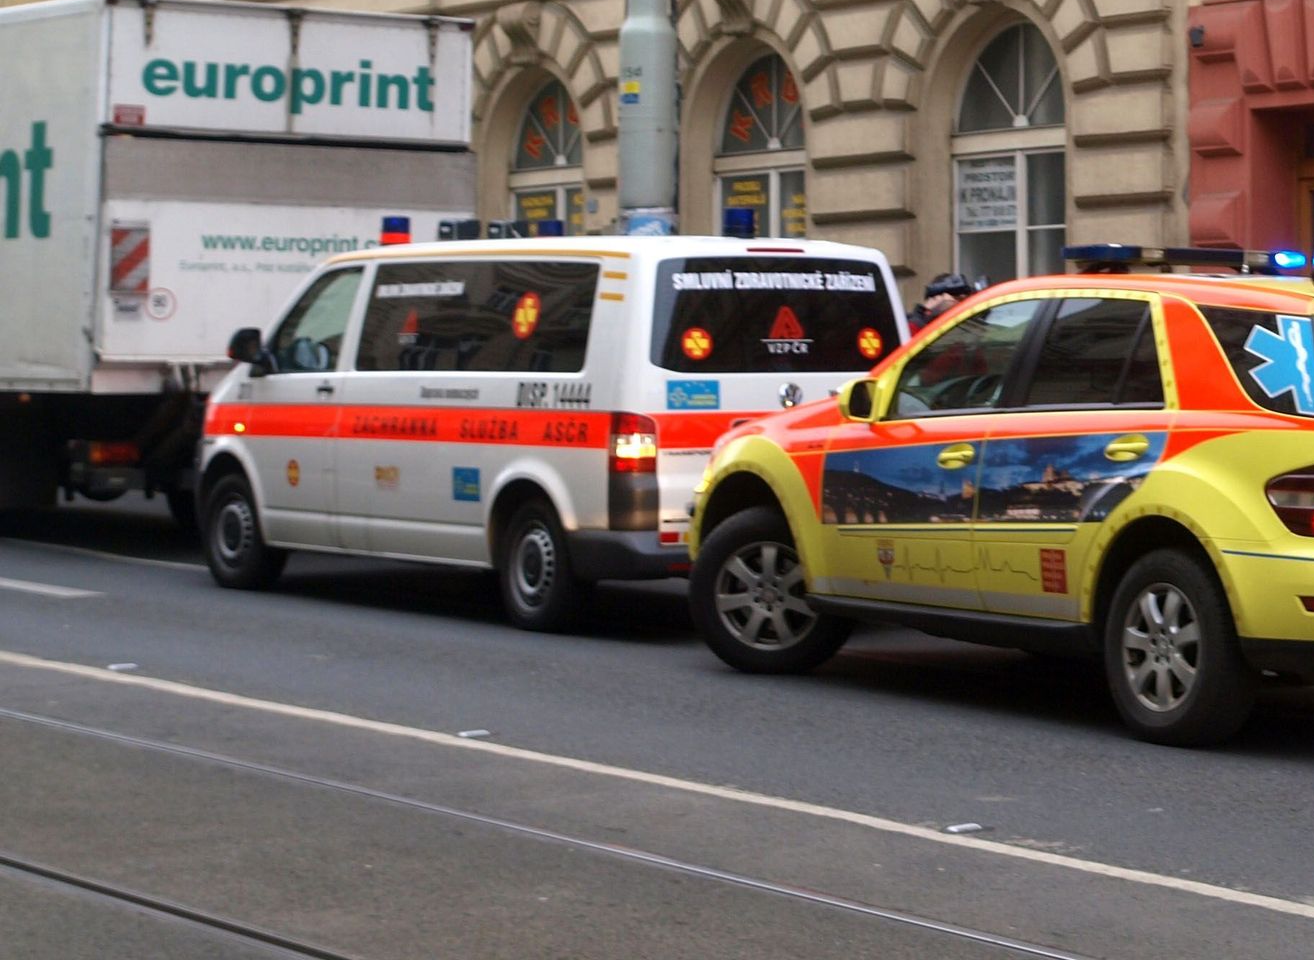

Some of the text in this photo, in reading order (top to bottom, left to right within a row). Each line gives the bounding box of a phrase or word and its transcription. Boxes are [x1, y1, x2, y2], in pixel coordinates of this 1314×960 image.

[141, 58, 435, 114] europrint
[201, 233, 380, 256] www.europrint.c
[553, 382, 592, 408] 14444
